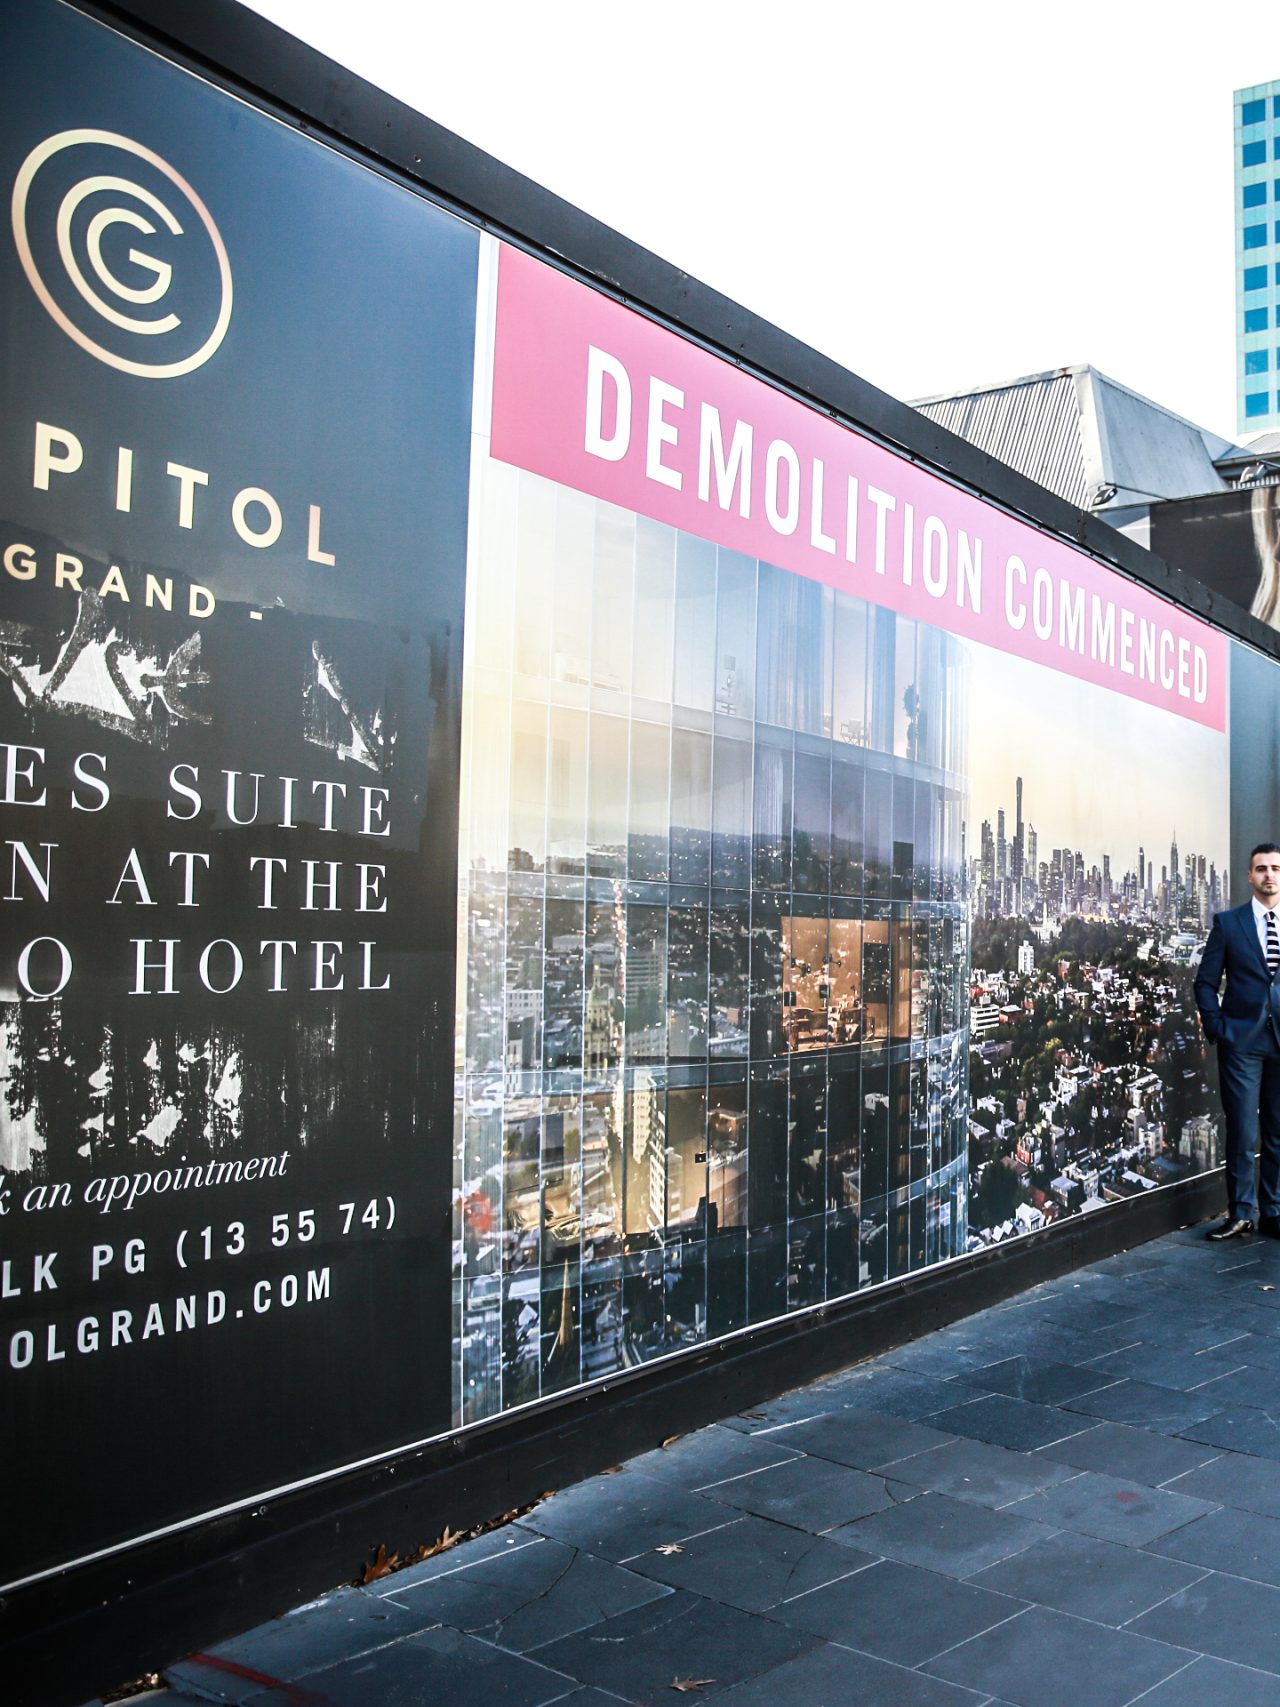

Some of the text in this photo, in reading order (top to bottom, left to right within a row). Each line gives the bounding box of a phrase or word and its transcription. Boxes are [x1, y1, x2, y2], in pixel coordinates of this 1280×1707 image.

[33, 421, 336, 567] PITOL
[584, 344, 1209, 704] DEMOLITION COMMENCED
[3, 543, 216, 619] GRAND
[167, 764, 391, 837] SUITE
[3, 840, 59, 902] N
[105, 848, 388, 912] AT THE
[17, 936, 391, 998] O HOTEL
[23, 1182, 72, 1212] an
[84, 1150, 291, 1213] appointment
[2, 1196, 397, 1299] LK PG (13 55 74)
[9, 1267, 331, 1370] OLGRAND.COM
